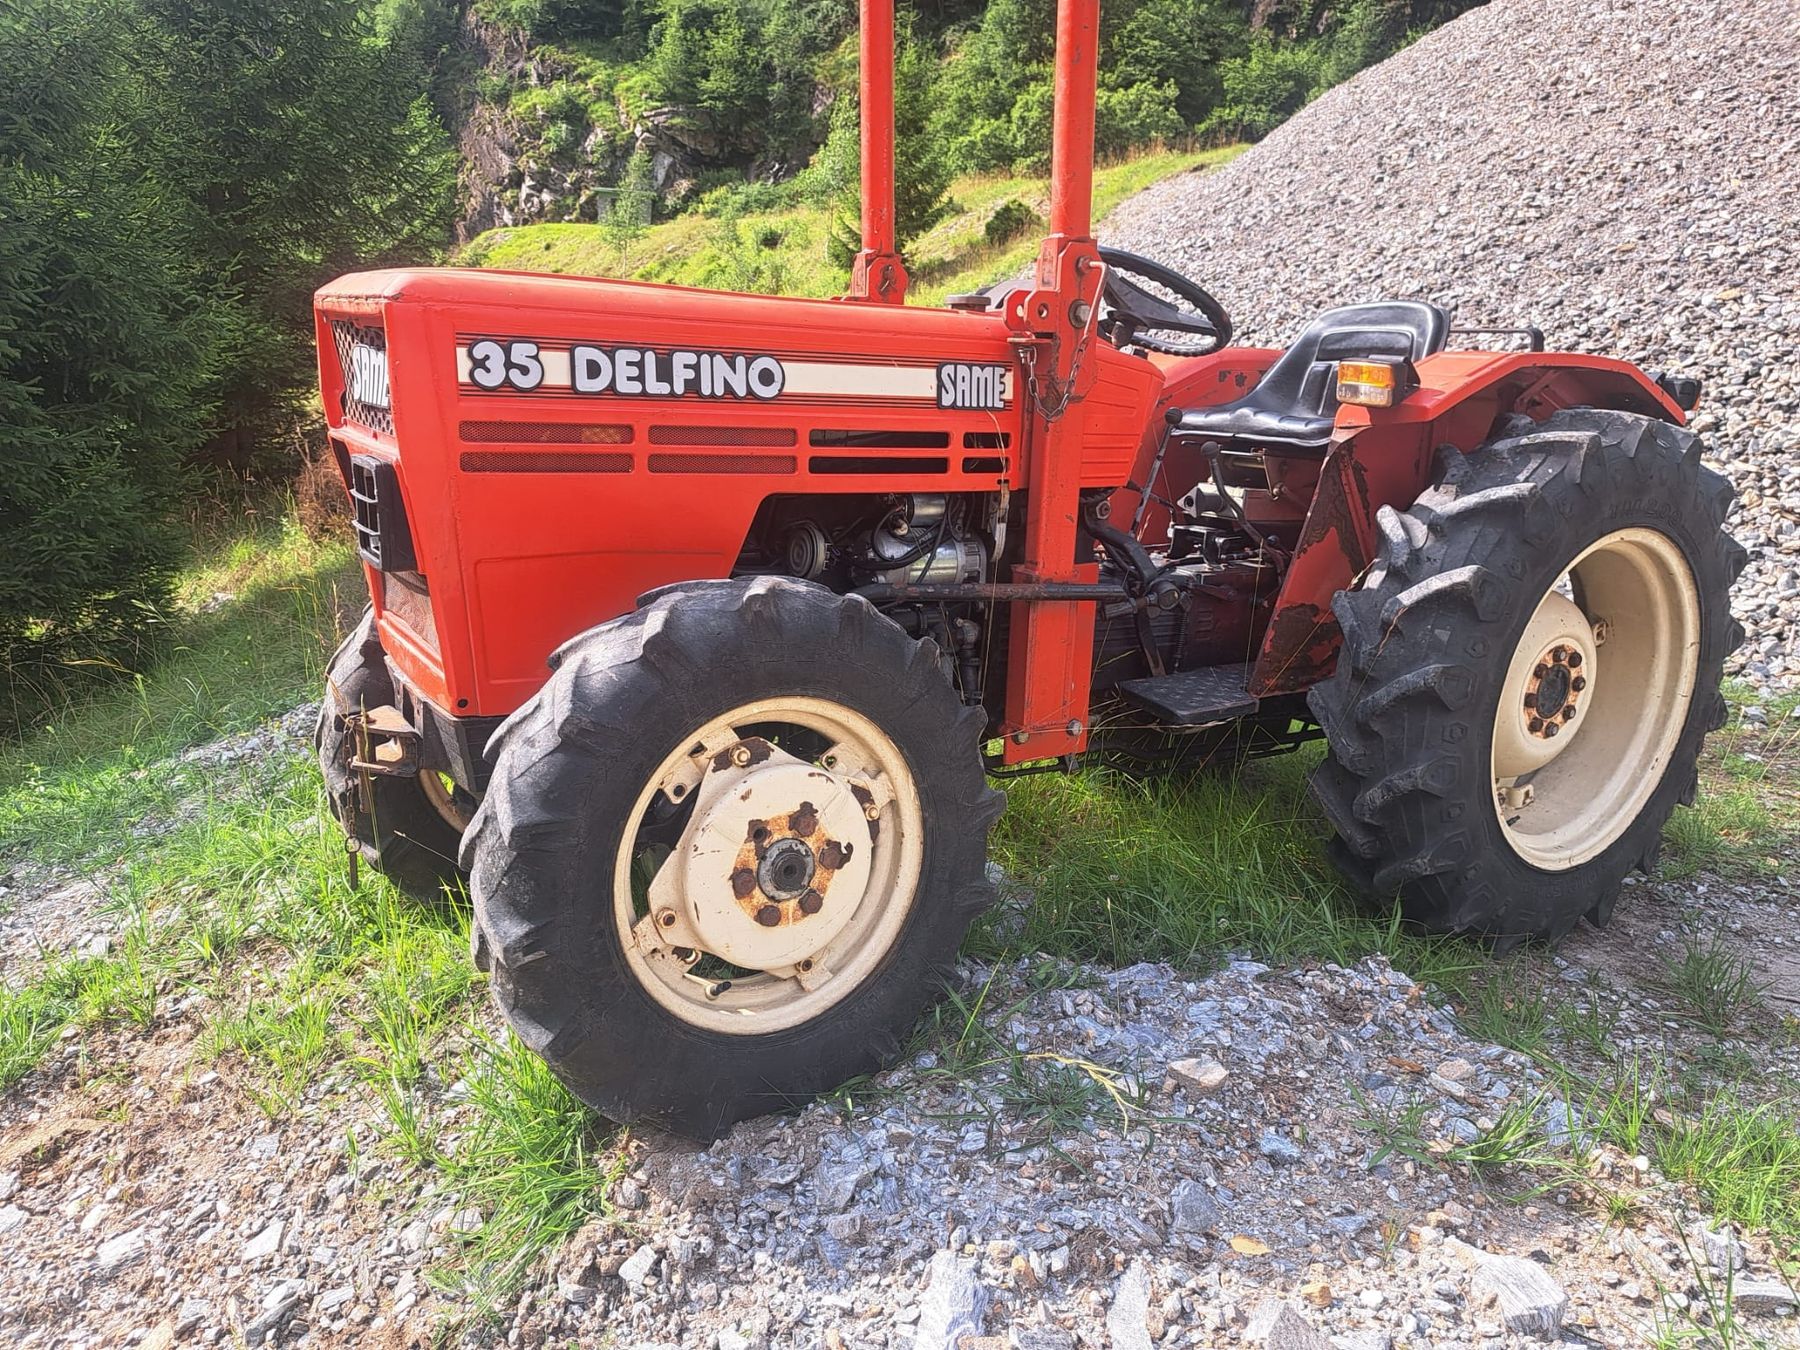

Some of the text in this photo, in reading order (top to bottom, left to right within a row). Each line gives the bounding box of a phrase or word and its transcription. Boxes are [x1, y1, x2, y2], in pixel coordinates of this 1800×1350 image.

[470, 339, 783, 399] 35 DELFINO
[940, 363, 1006, 409] SAME
